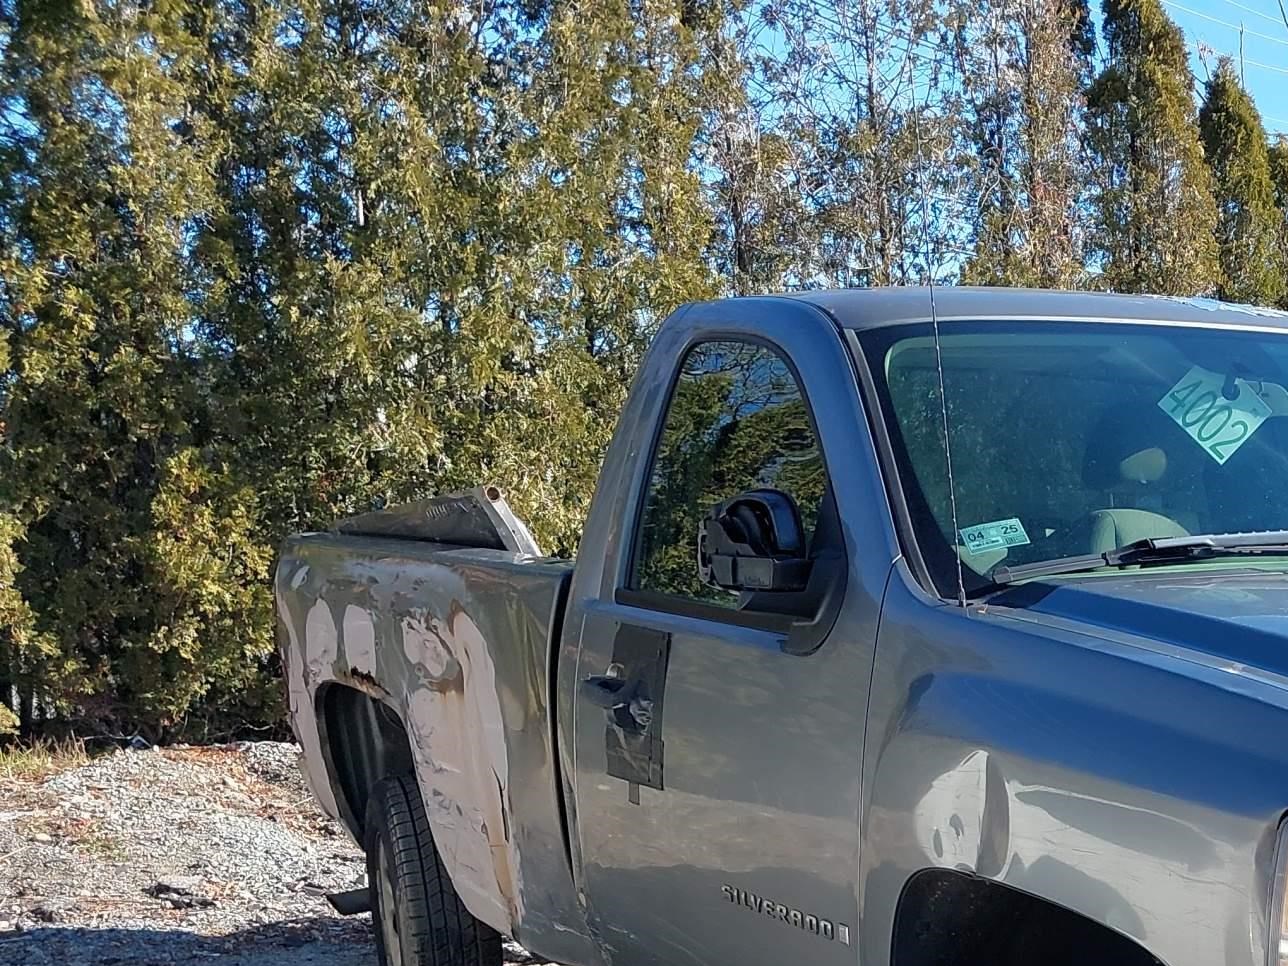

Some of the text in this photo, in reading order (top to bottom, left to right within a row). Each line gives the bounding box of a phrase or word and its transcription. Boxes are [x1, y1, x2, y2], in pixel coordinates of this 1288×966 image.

[1168, 380, 1249, 460] 4002
[967, 524, 1019, 542] 04 25
[721, 884, 835, 941] SILVERADO
